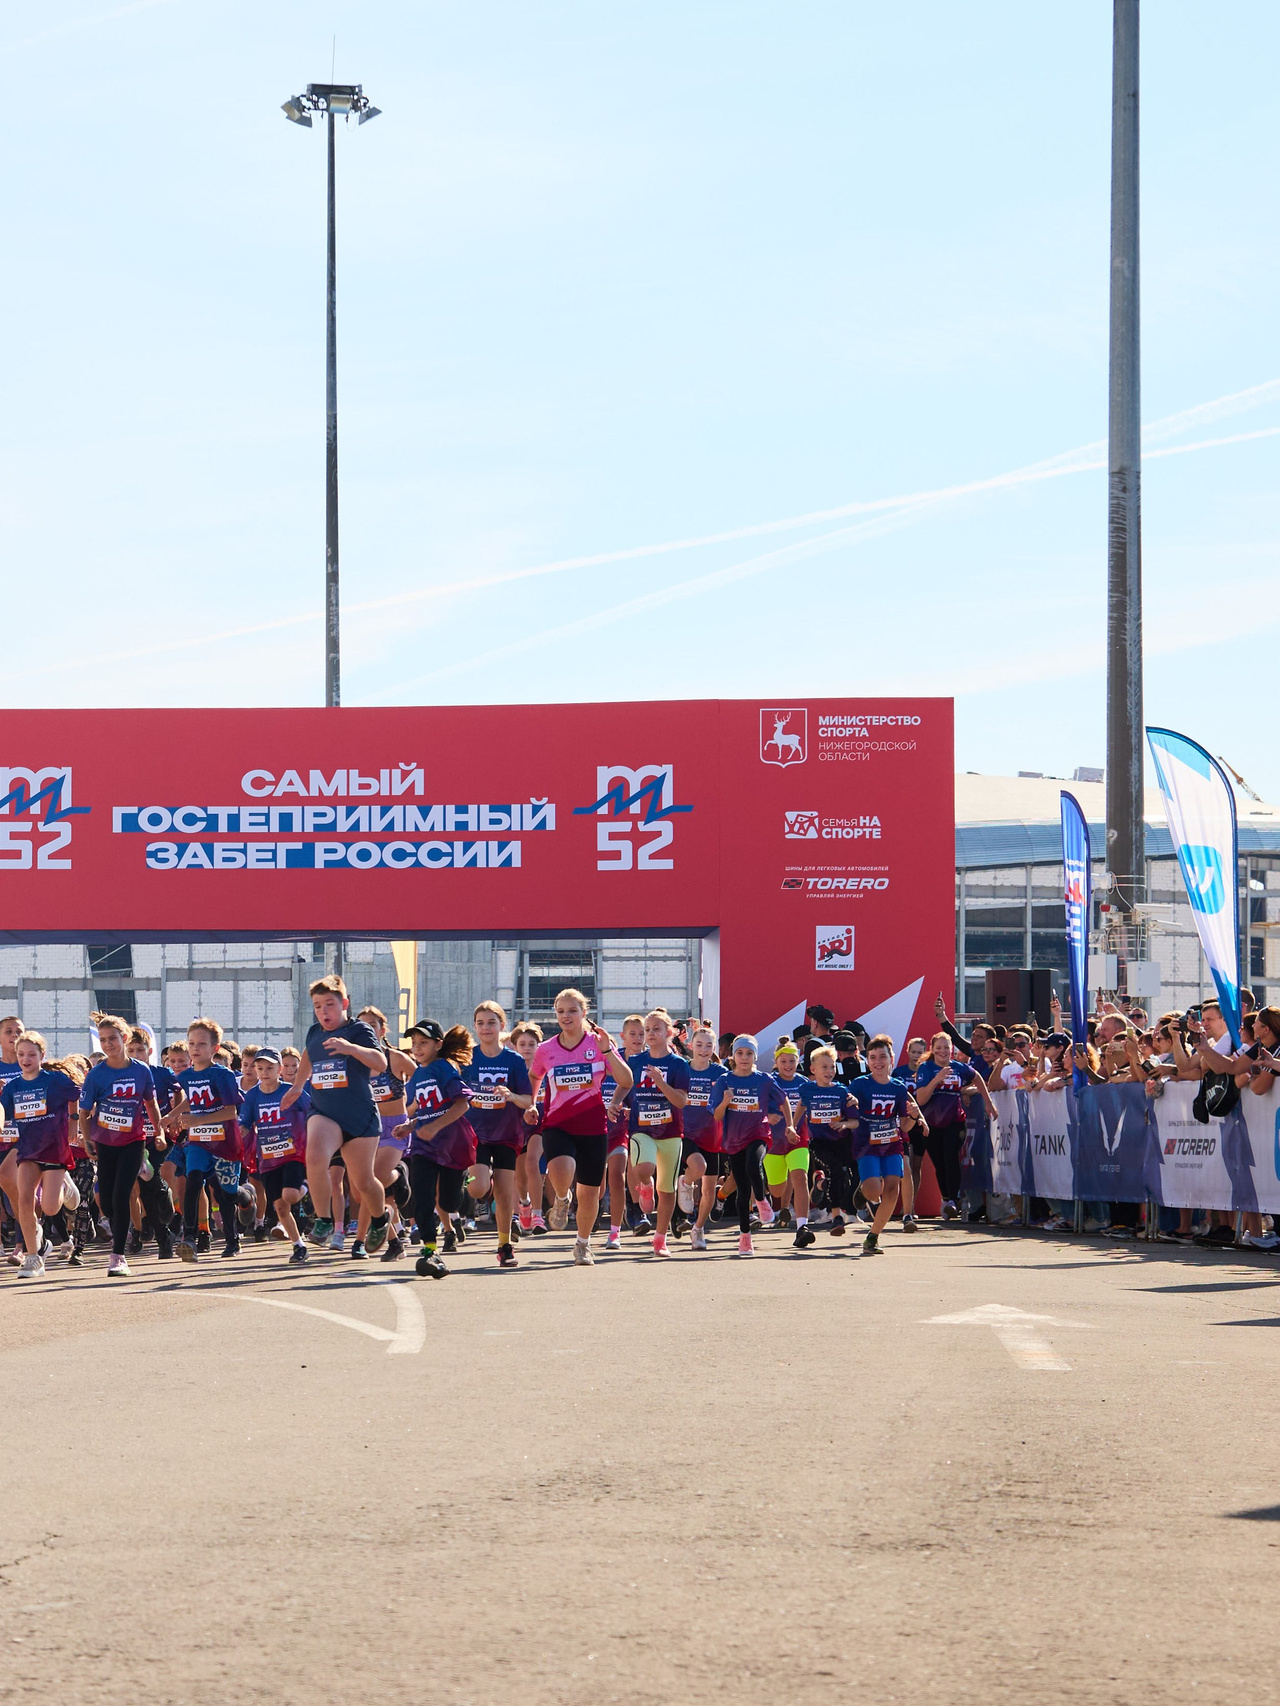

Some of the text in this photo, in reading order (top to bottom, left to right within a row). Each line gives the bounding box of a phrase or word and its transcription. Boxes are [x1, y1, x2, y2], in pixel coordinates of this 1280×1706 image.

[818, 716, 921, 726] МИНИСТЕРСТВО
[818, 727, 869, 737] СПОРТА
[818, 740, 917, 751] НИЖЕГОРОДСКОЙ
[818, 752, 870, 761] ОБЛАСТИ
[241, 762, 425, 797] САМЫЙ
[112, 797, 556, 833] ГОСТЕПРИИМНЫЙ
[821, 815, 881, 827] СЕМЬЯ НА
[821, 828, 882, 839] СПОРТЕ
[597, 820, 674, 870] 52
[145, 840, 521, 869] ЗАБЕГ РОССИИ
[806, 877, 889, 890] TORERO
[103, 1115, 127, 1124] 10149
[1034, 1135, 1066, 1155] TANK
[1176, 1138, 1216, 1155] TORERO
